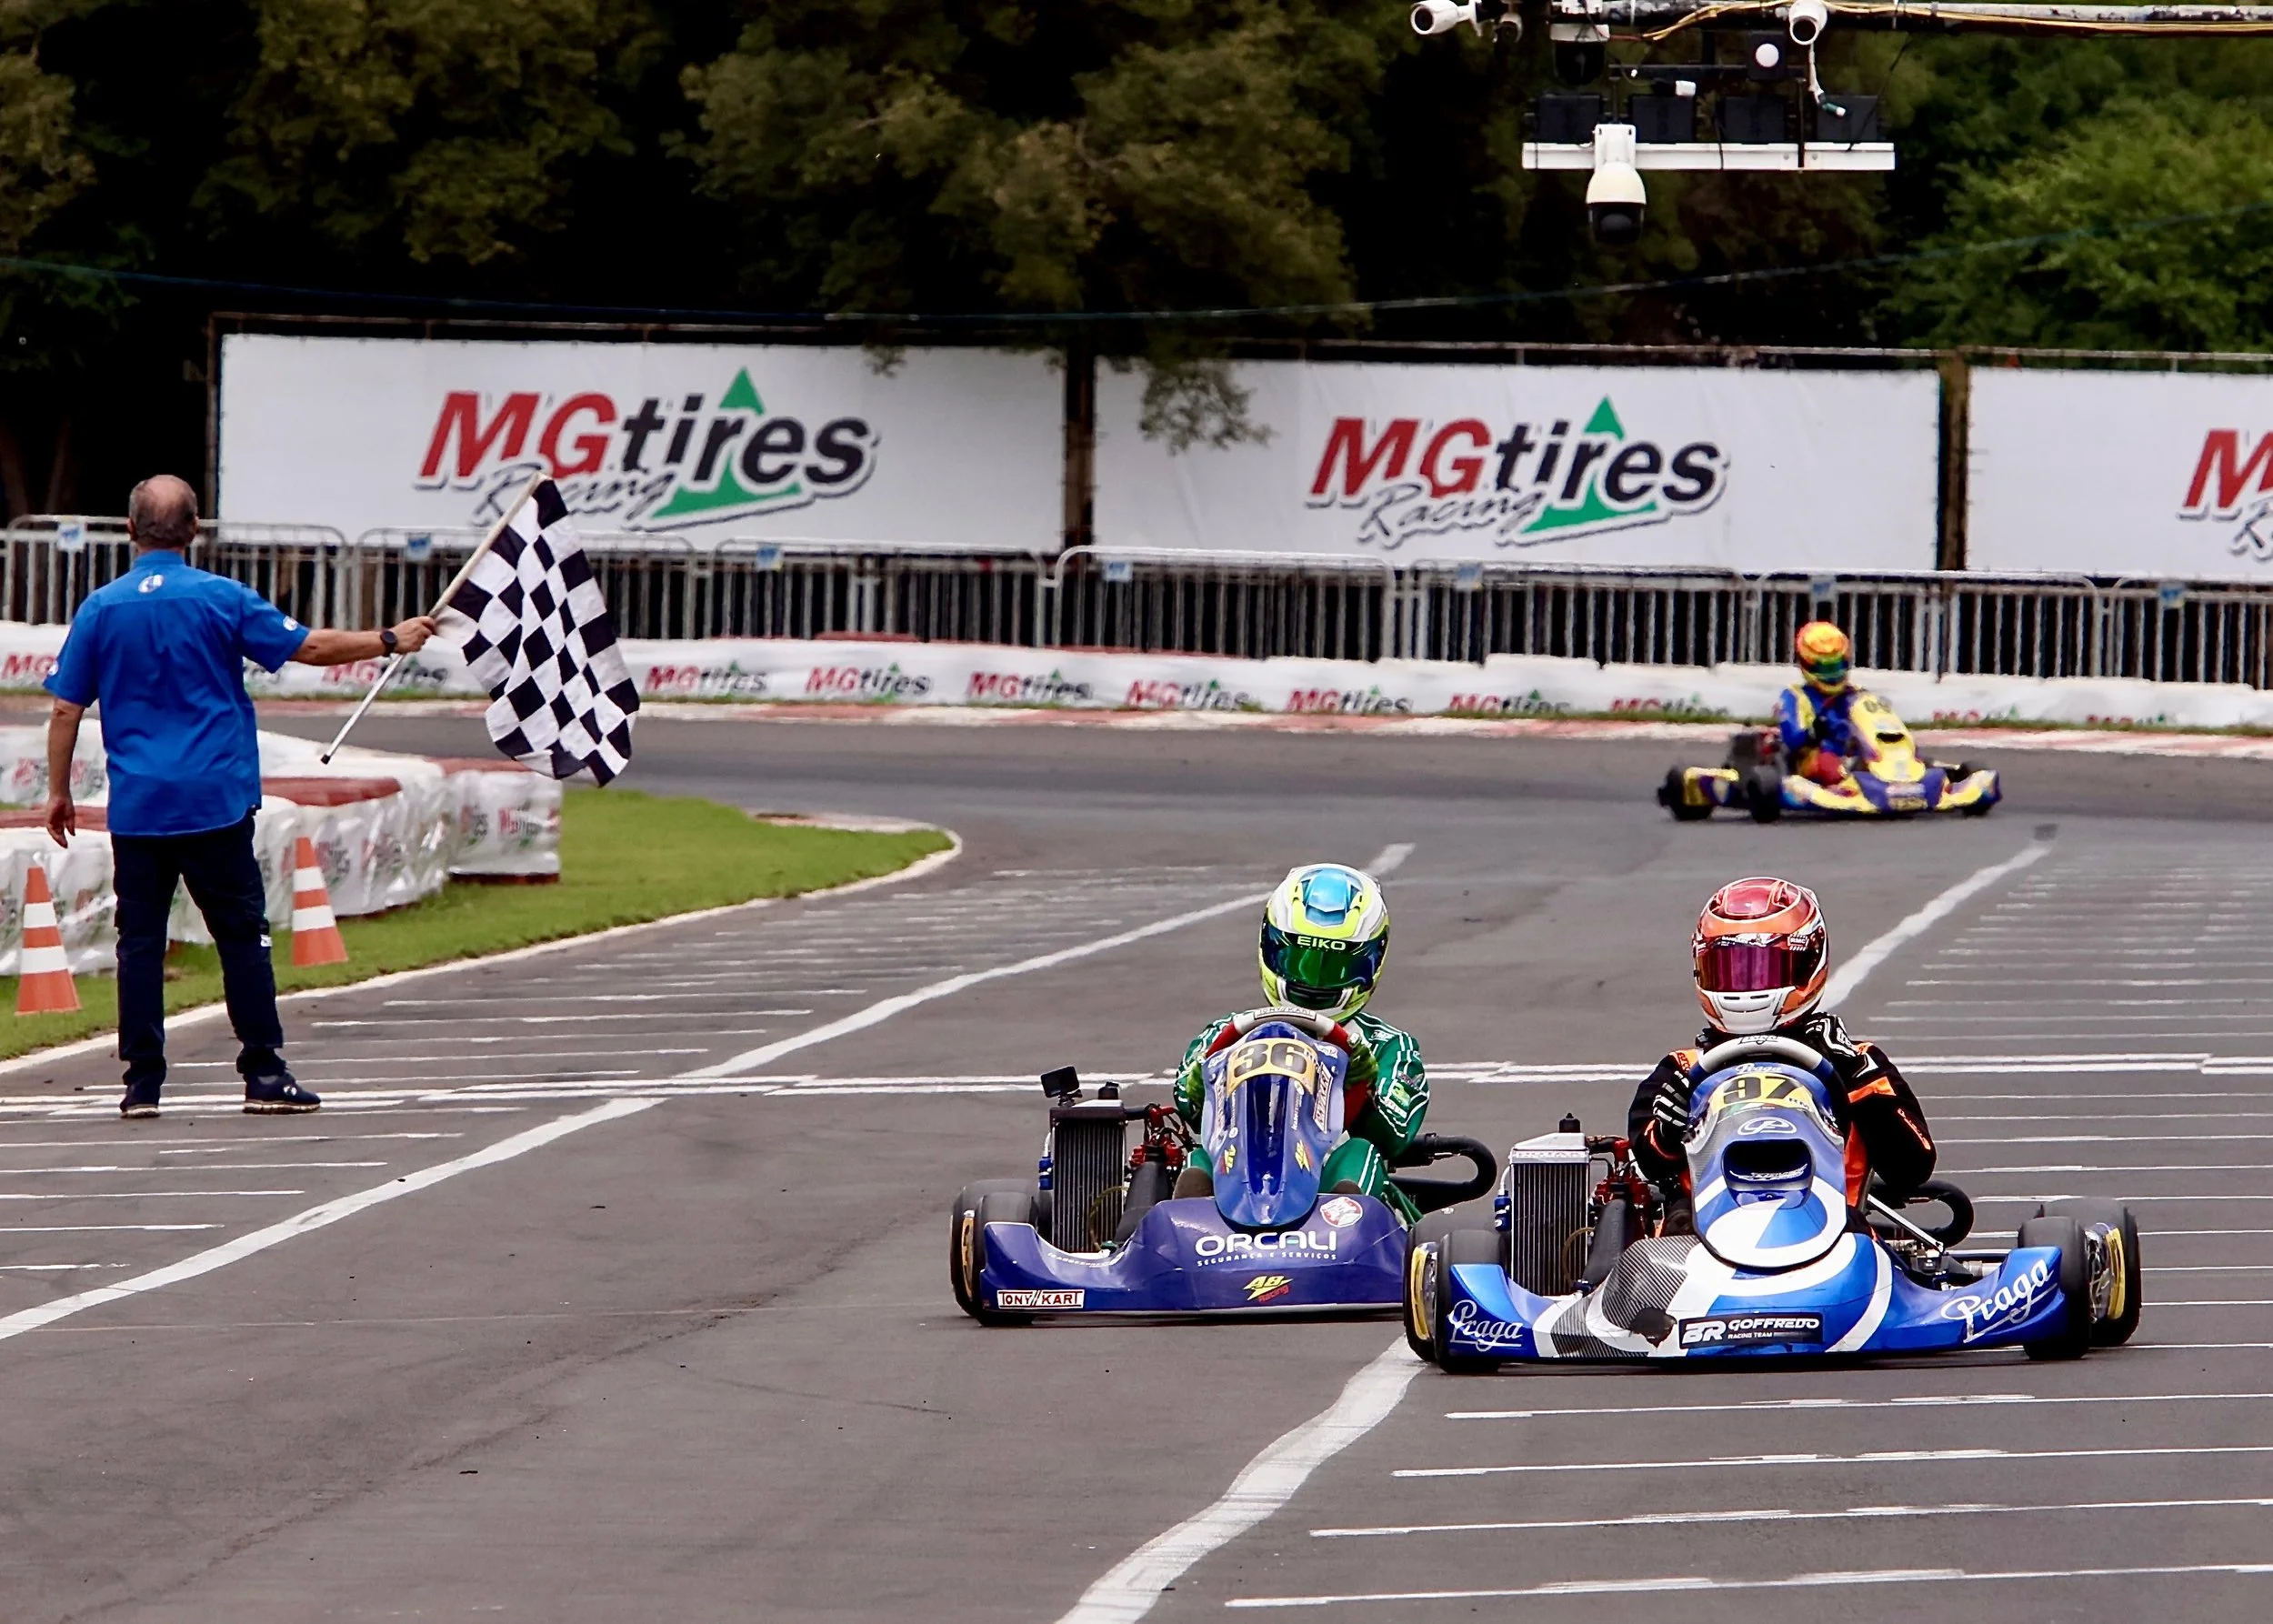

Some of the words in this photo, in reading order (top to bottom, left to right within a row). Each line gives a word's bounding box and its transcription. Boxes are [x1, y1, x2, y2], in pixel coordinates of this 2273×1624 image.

[420, 389, 871, 485] MGtires
[1310, 417, 1721, 503] MGtires
[1297, 935, 1346, 951] EIKO
[1234, 1043, 1307, 1078] 36
[1723, 1076, 1798, 1105] 97
[1196, 1230, 1337, 1257] ORCALI
[1940, 1258, 2058, 1344] Praga
[1447, 1299, 1524, 1352] Praga
[1727, 1318, 1820, 1331] GOFFREDO
